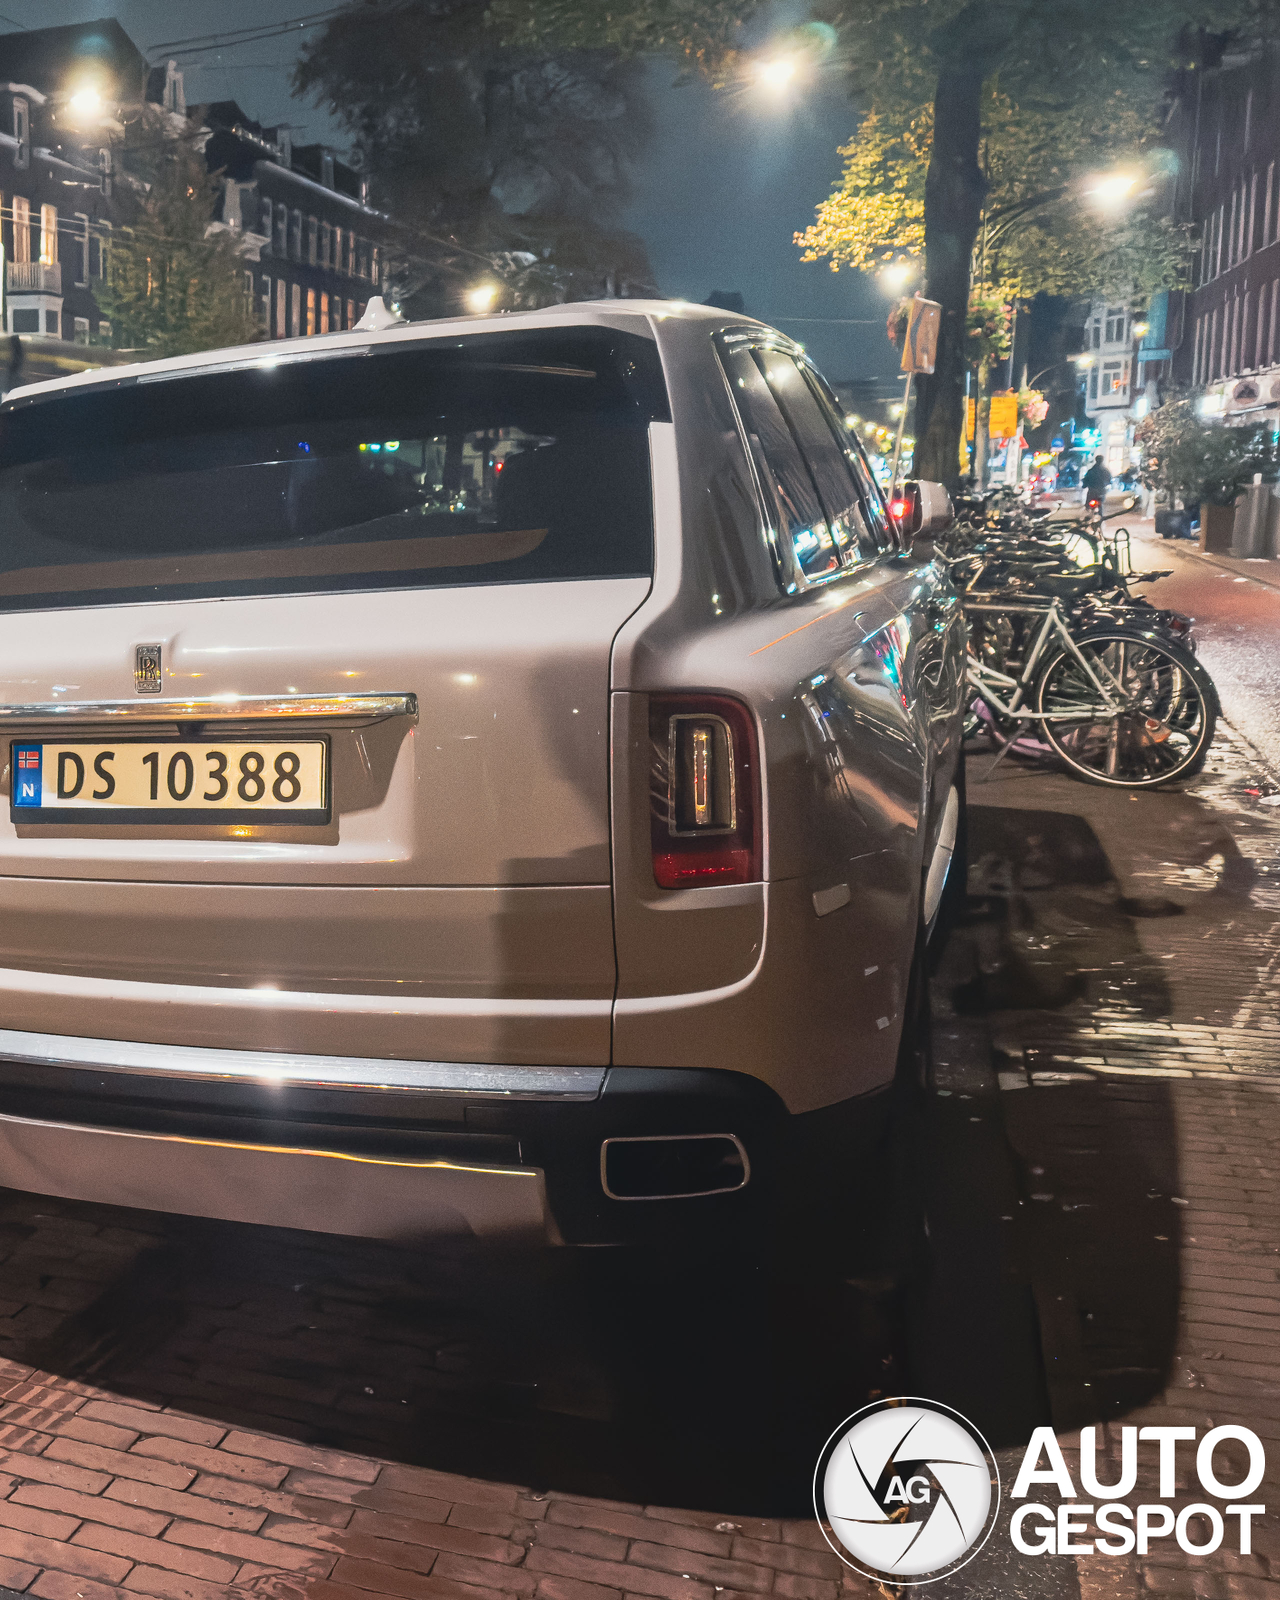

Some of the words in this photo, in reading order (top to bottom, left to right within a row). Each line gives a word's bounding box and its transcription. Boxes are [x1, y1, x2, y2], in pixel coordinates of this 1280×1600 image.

[22, 783, 35, 798] N
[57, 751, 116, 800] DS
[142, 750, 302, 803] 10388
